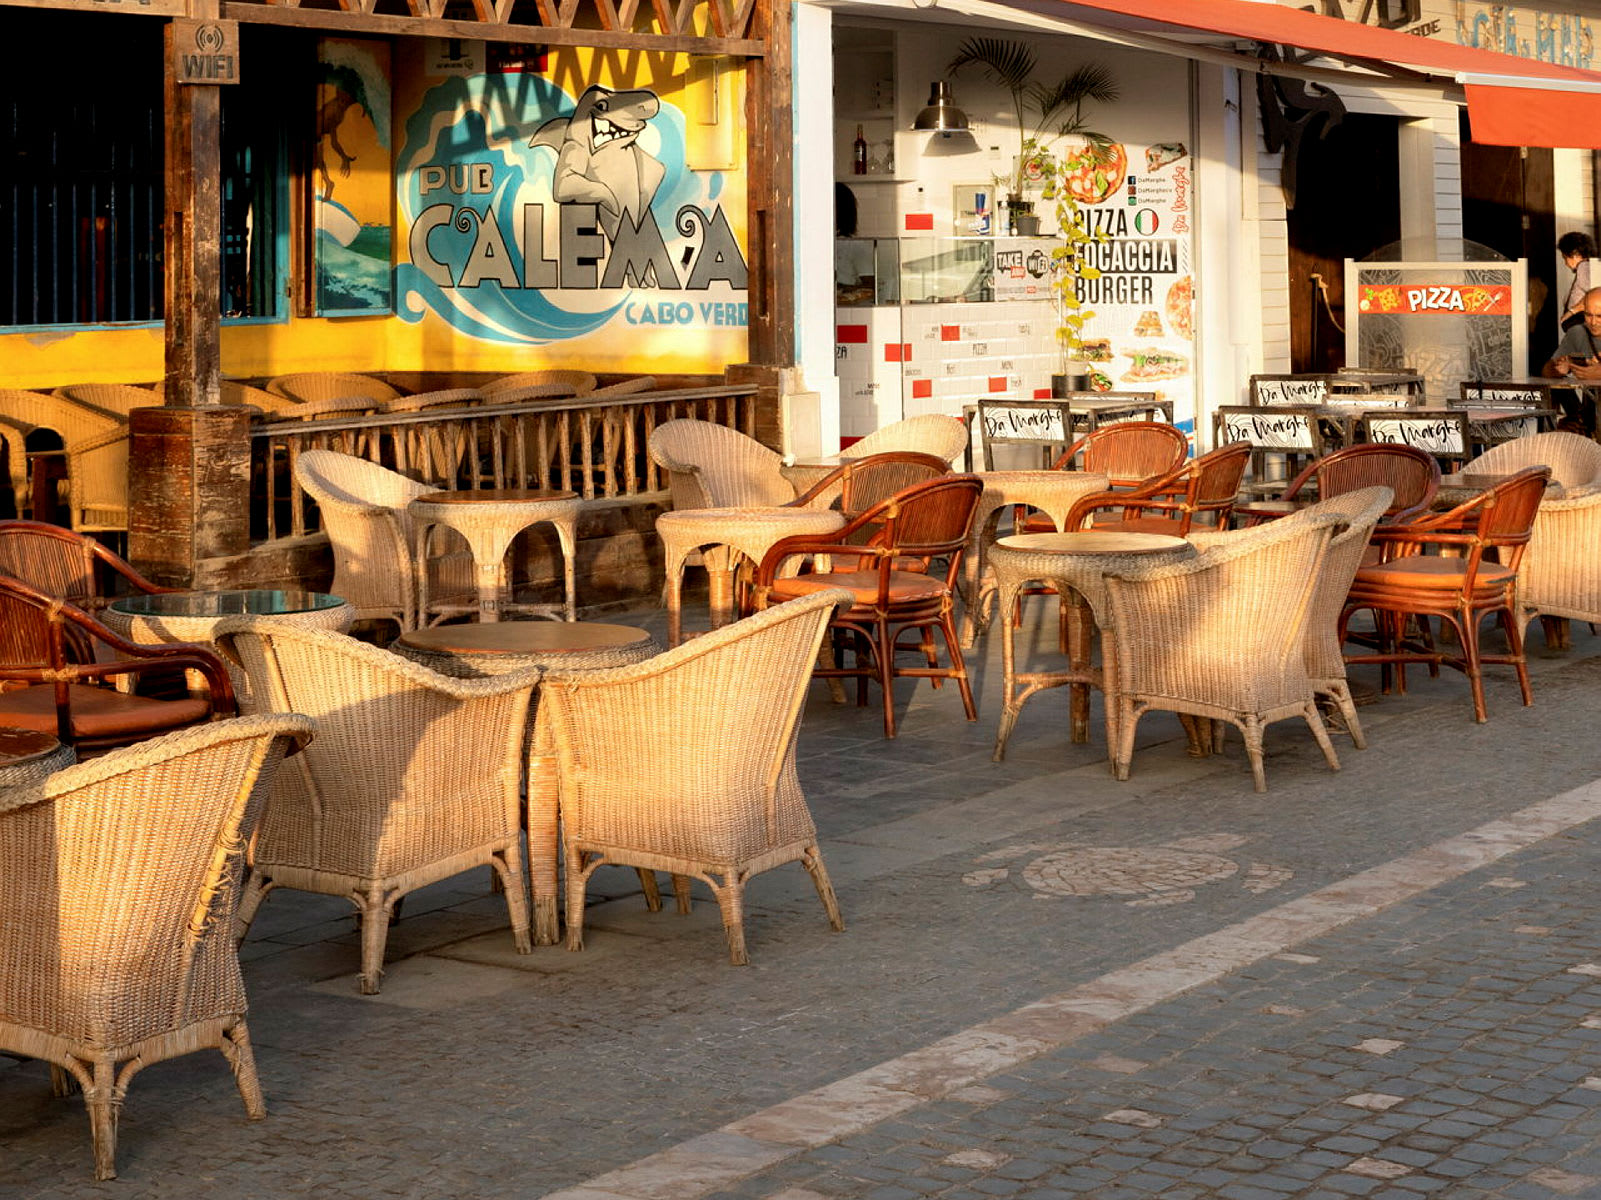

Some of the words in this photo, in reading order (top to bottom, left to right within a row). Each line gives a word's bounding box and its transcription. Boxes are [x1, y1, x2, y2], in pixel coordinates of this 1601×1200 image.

[182, 54, 234, 80] WIFI
[418, 163, 495, 195] PUB
[408, 202, 749, 291] CALEMA
[997, 252, 1022, 267] TAKE
[1074, 240, 1174, 272] FOCACCIA
[1075, 275, 1153, 305] BURGER
[1408, 286, 1465, 312] PIZZA
[624, 301, 694, 326] CABO
[1260, 386, 1277, 405] Da
[1281, 380, 1326, 401] Margh
[985, 416, 1006, 438] Da
